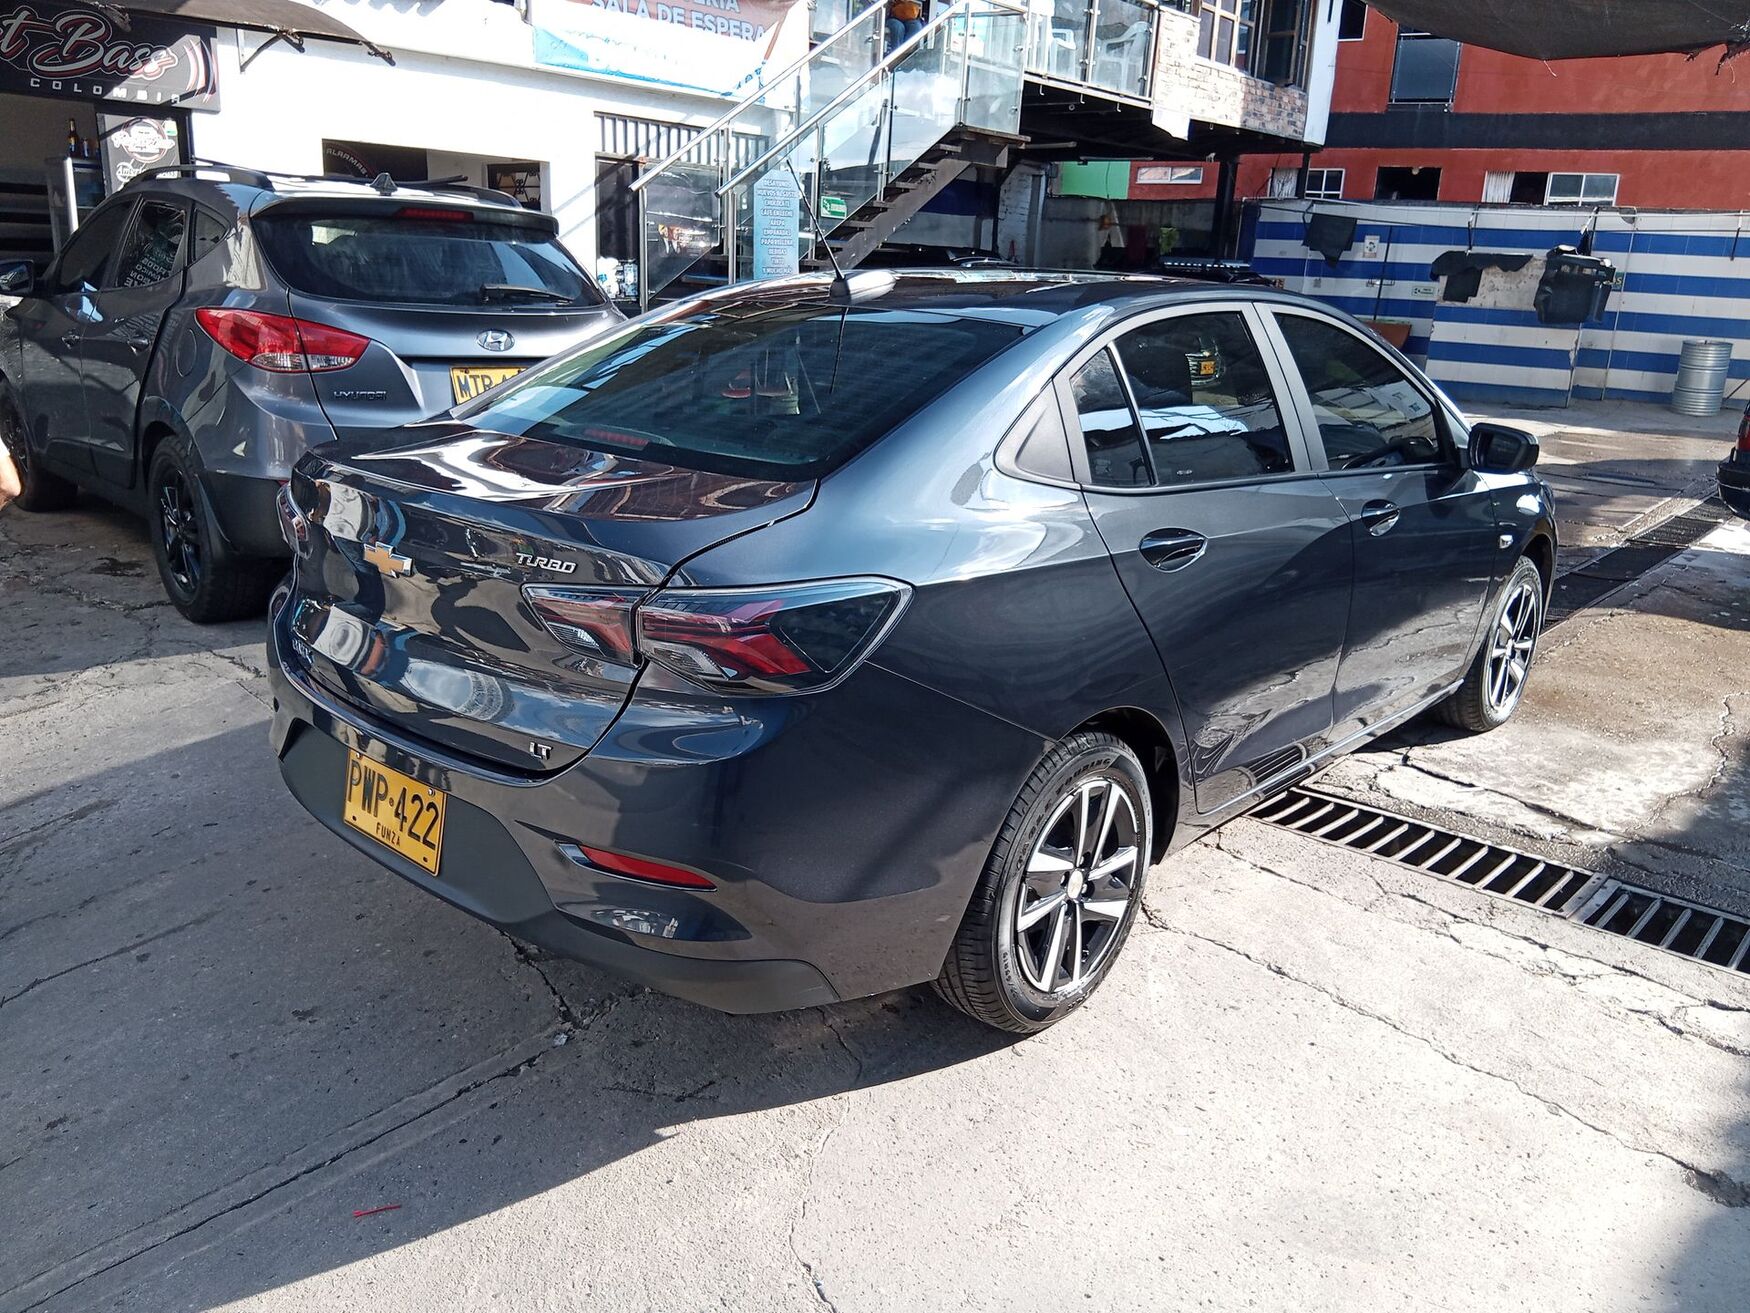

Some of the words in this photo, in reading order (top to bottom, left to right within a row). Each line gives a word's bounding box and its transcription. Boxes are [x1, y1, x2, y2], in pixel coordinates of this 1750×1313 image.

[656, 3, 686, 25] DE
[691, 10, 766, 42] ESPERA
[30, 78, 180, 104] COLOMBIA
[456, 374, 508, 398] MTR
[515, 552, 577, 574] TURBO
[529, 741, 552, 760] LT
[375, 821, 401, 847] FUNZA
